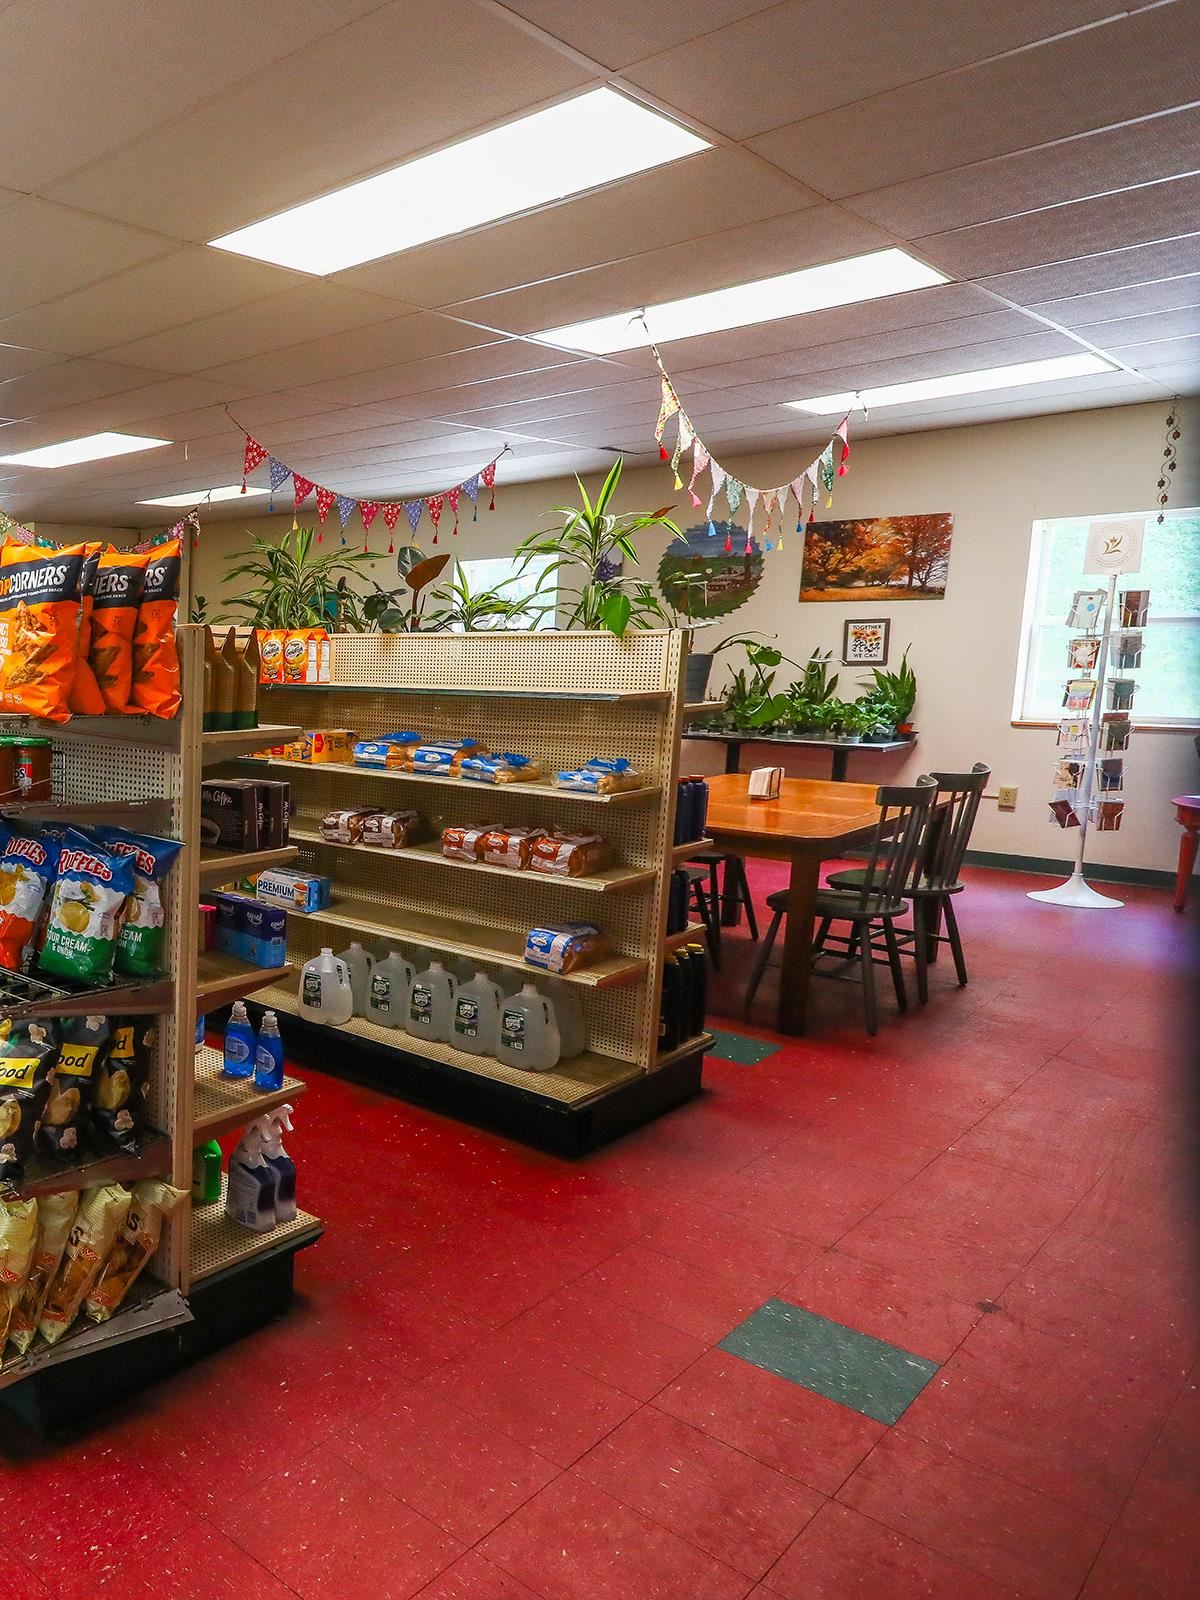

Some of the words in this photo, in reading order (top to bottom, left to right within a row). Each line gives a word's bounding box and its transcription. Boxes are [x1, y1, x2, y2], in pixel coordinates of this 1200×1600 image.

[213, 790, 233, 806] Coffee
[5, 836, 48, 866] UFFLES
[58, 849, 113, 881] RUFFLES
[257, 880, 296, 898] PREMIUM
[60, 935, 89, 953] CREAM
